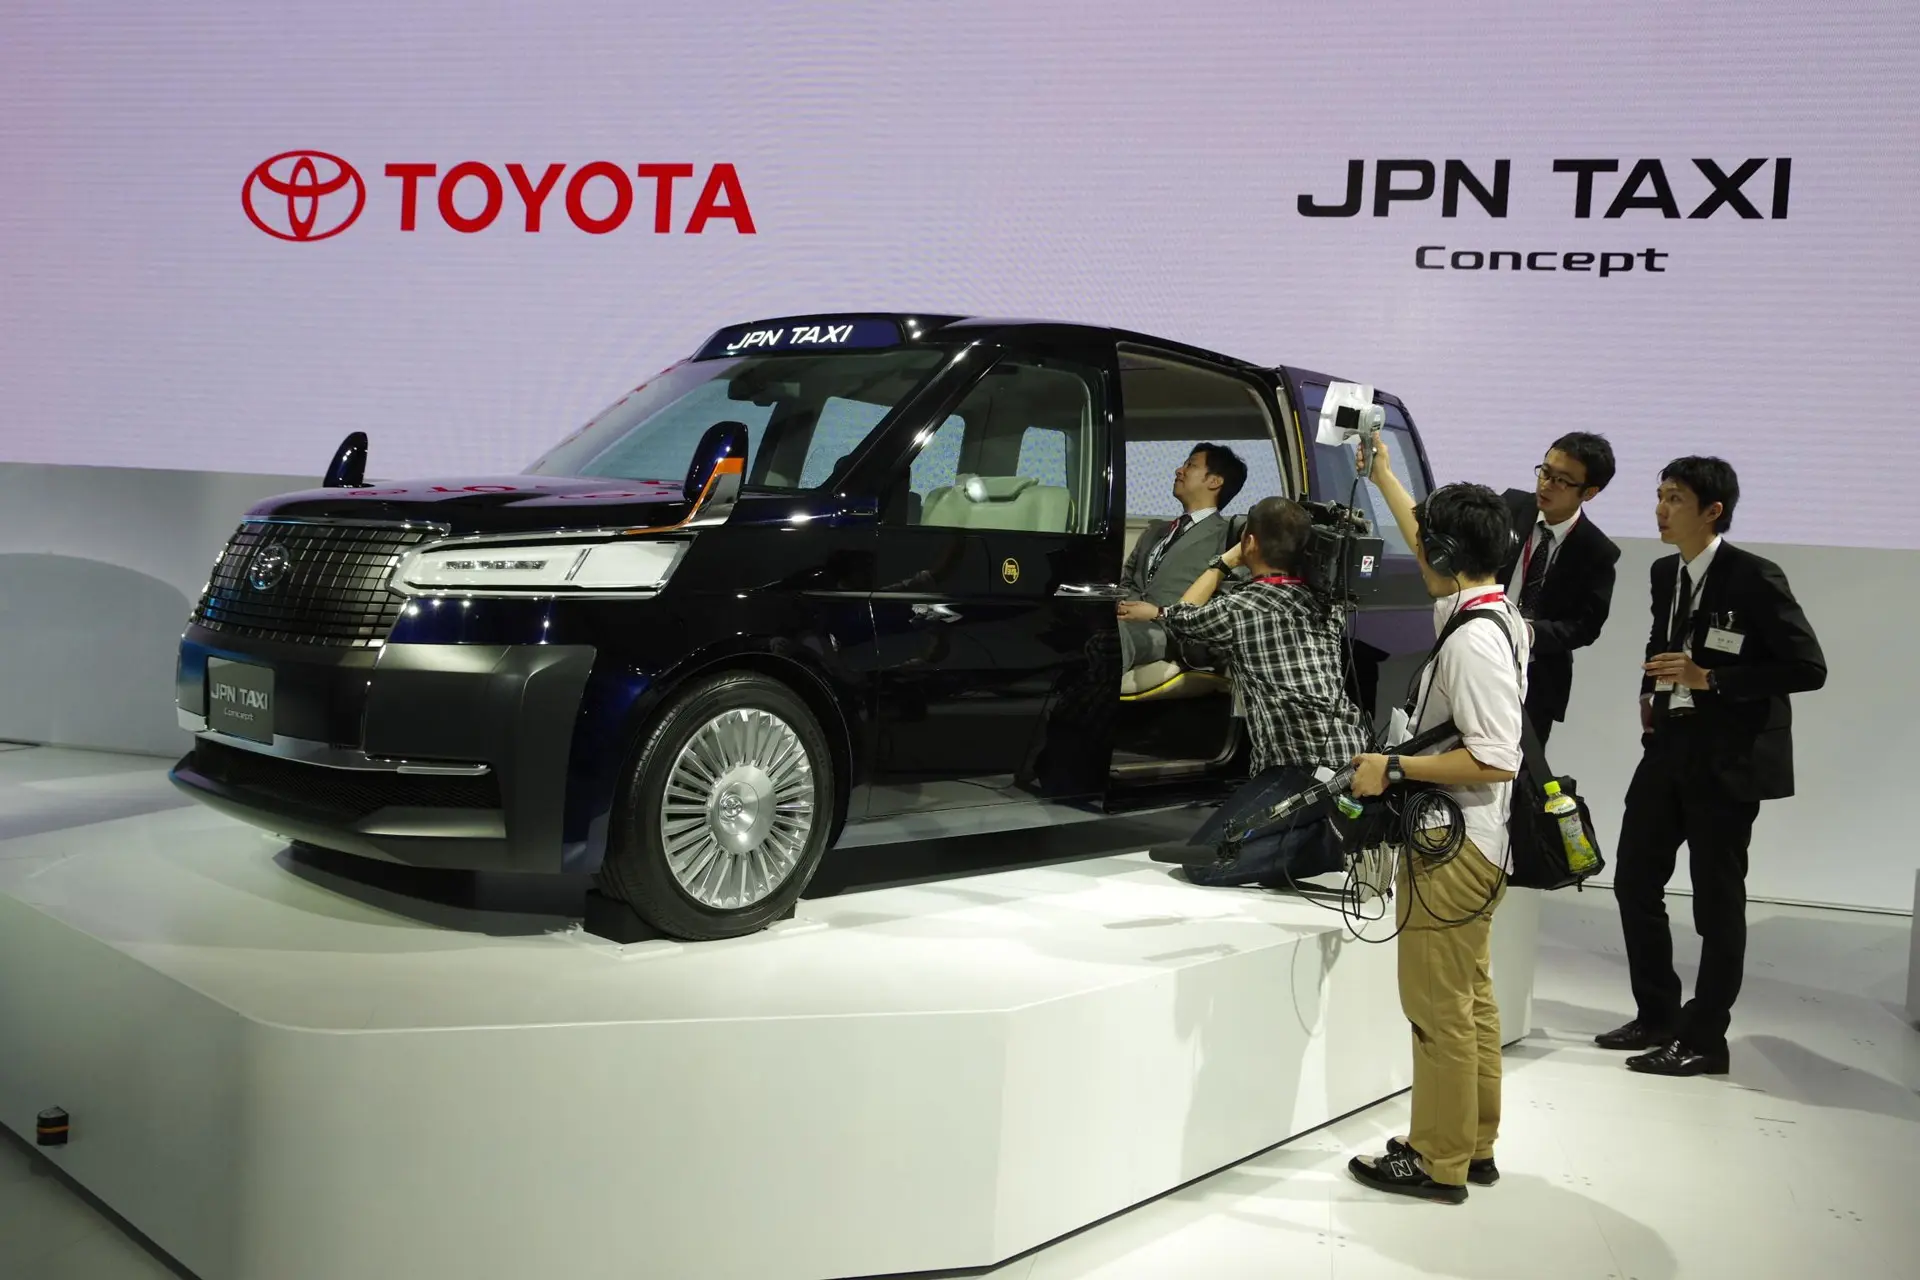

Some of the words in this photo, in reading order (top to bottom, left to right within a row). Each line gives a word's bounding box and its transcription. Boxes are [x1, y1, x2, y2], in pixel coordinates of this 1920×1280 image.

[384, 161, 757, 234] TOYOTA
[1297, 159, 1511, 218] JPN
[1553, 158, 1791, 219] TAXI
[1416, 246, 1669, 277] Concept
[726, 328, 784, 350] JPN
[789, 324, 854, 345] TAXI
[211, 683, 236, 704] JPN
[239, 688, 268, 710] TAXI
